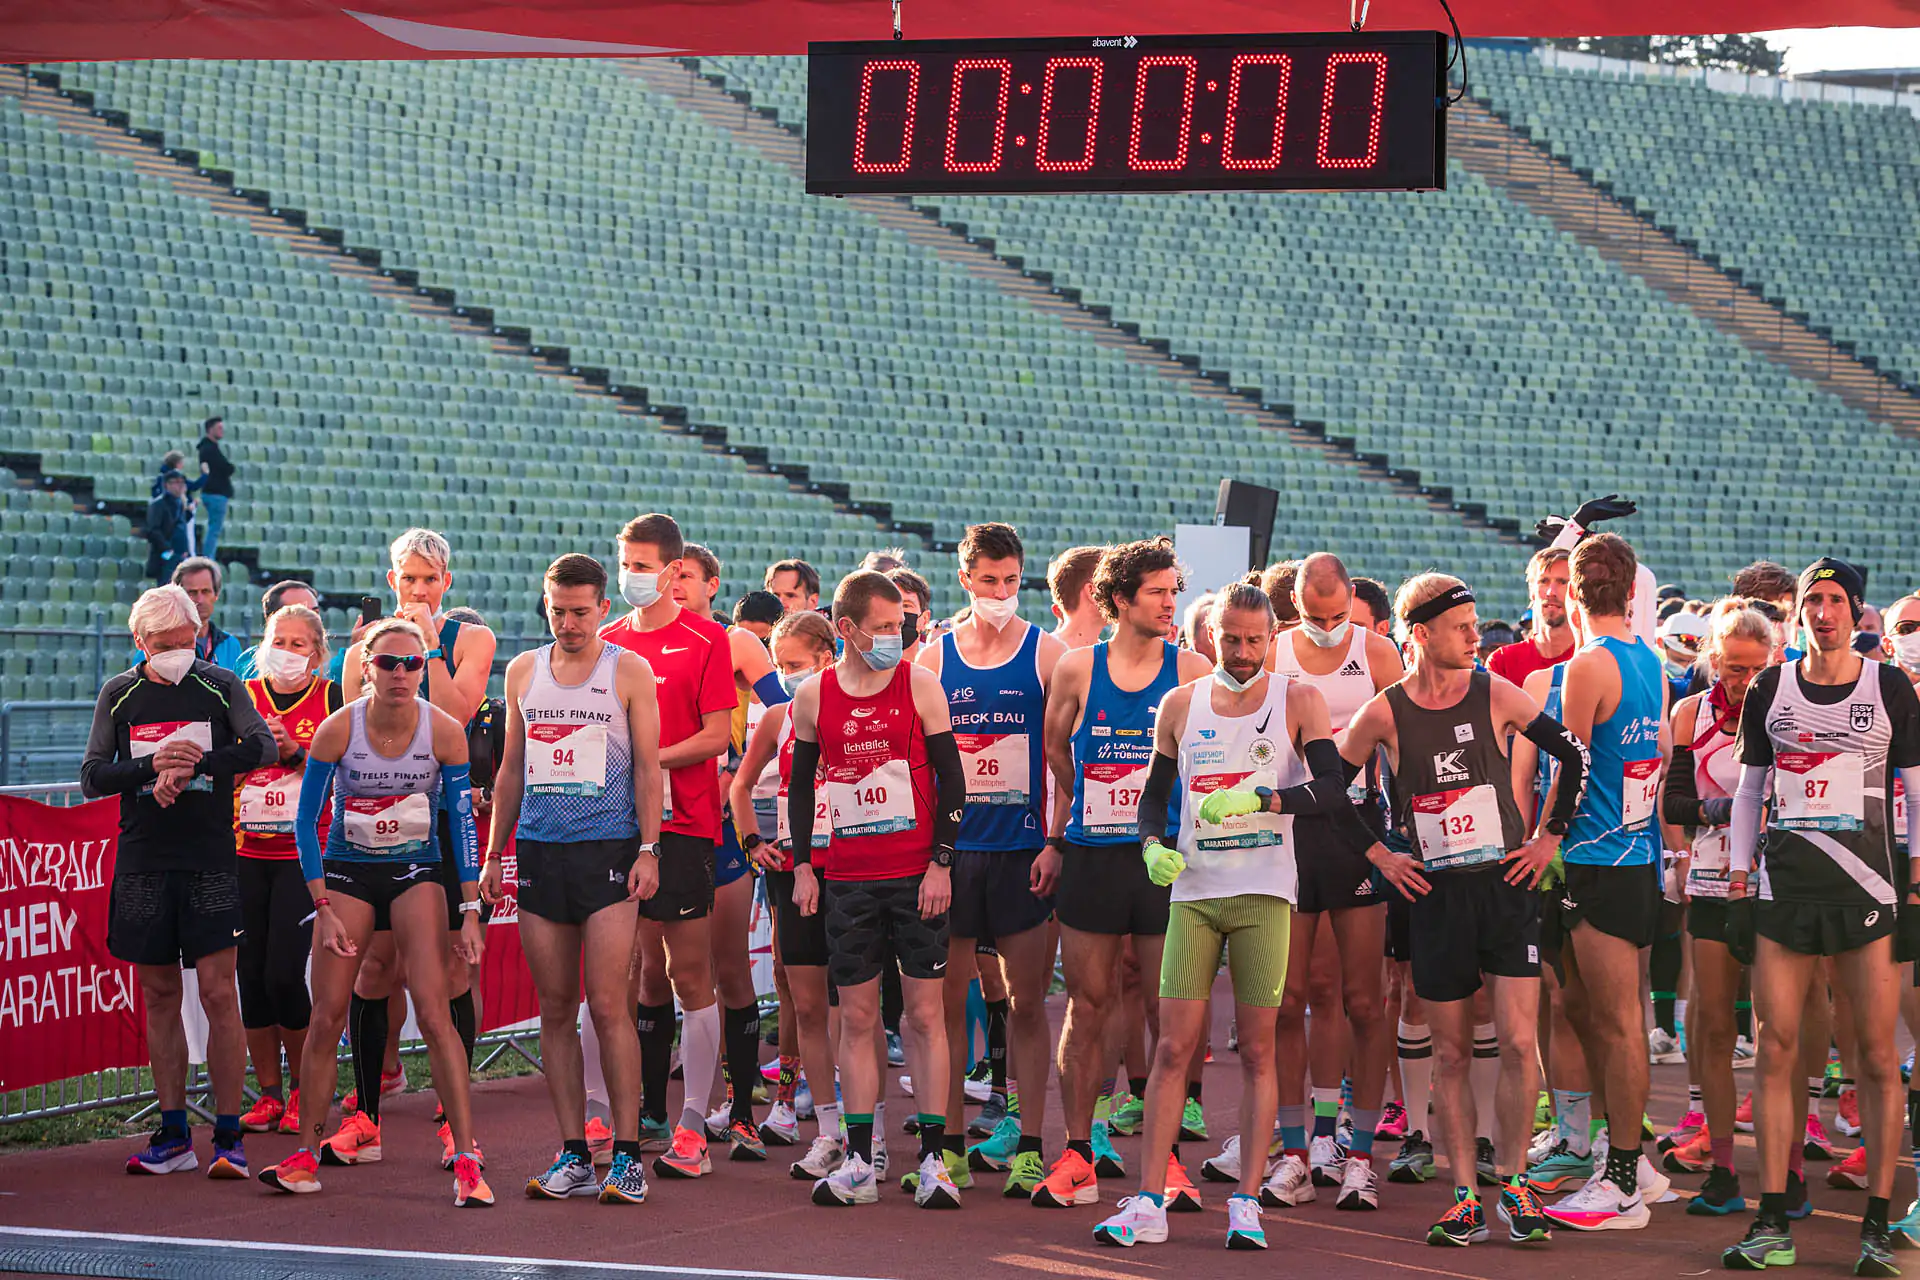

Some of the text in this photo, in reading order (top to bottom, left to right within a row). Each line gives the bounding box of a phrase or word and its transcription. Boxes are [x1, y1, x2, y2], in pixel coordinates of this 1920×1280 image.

[1092, 37, 1122, 47] abavent
[538, 710, 612, 722] TELIS FINANZ
[952, 712, 1025, 726] BECK BAU
[844, 739, 889, 755] LichtBlick
[553, 748, 575, 766] 94
[1114, 750, 1151, 760] TÜBING
[1194, 750, 1223, 759] LAUFSHOP
[528, 765, 534, 775] A
[977, 758, 999, 776] 26
[362, 771, 431, 780] TELIS FINANZ
[1437, 773, 1470, 783] KIEFER
[970, 778, 1006, 787] Christopher
[565, 786, 581, 794] 2021
[1642, 784, 1656, 801] 14
[1804, 780, 1829, 798] 87
[264, 790, 285, 807] 60
[854, 786, 887, 806] 140
[965, 795, 991, 803] RATHON
[1108, 789, 1141, 806] 137
[1779, 797, 1786, 807] A
[834, 808, 840, 818] A
[864, 809, 880, 817] Jens
[1085, 805, 1092, 815] A
[375, 820, 399, 834] 93
[779, 822, 784, 830] A
[842, 823, 893, 835] MARATHON 2021
[1195, 820, 1201, 829] A
[1222, 821, 1248, 830] Marcus
[1439, 814, 1475, 836] 132
[1784, 820, 1819, 828] MARATHON
[1091, 826, 1127, 834] MARATHON
[1203, 840, 1240, 848] MARATHON
[1422, 840, 1429, 850] A
[1432, 856, 1465, 868] MARATHON
